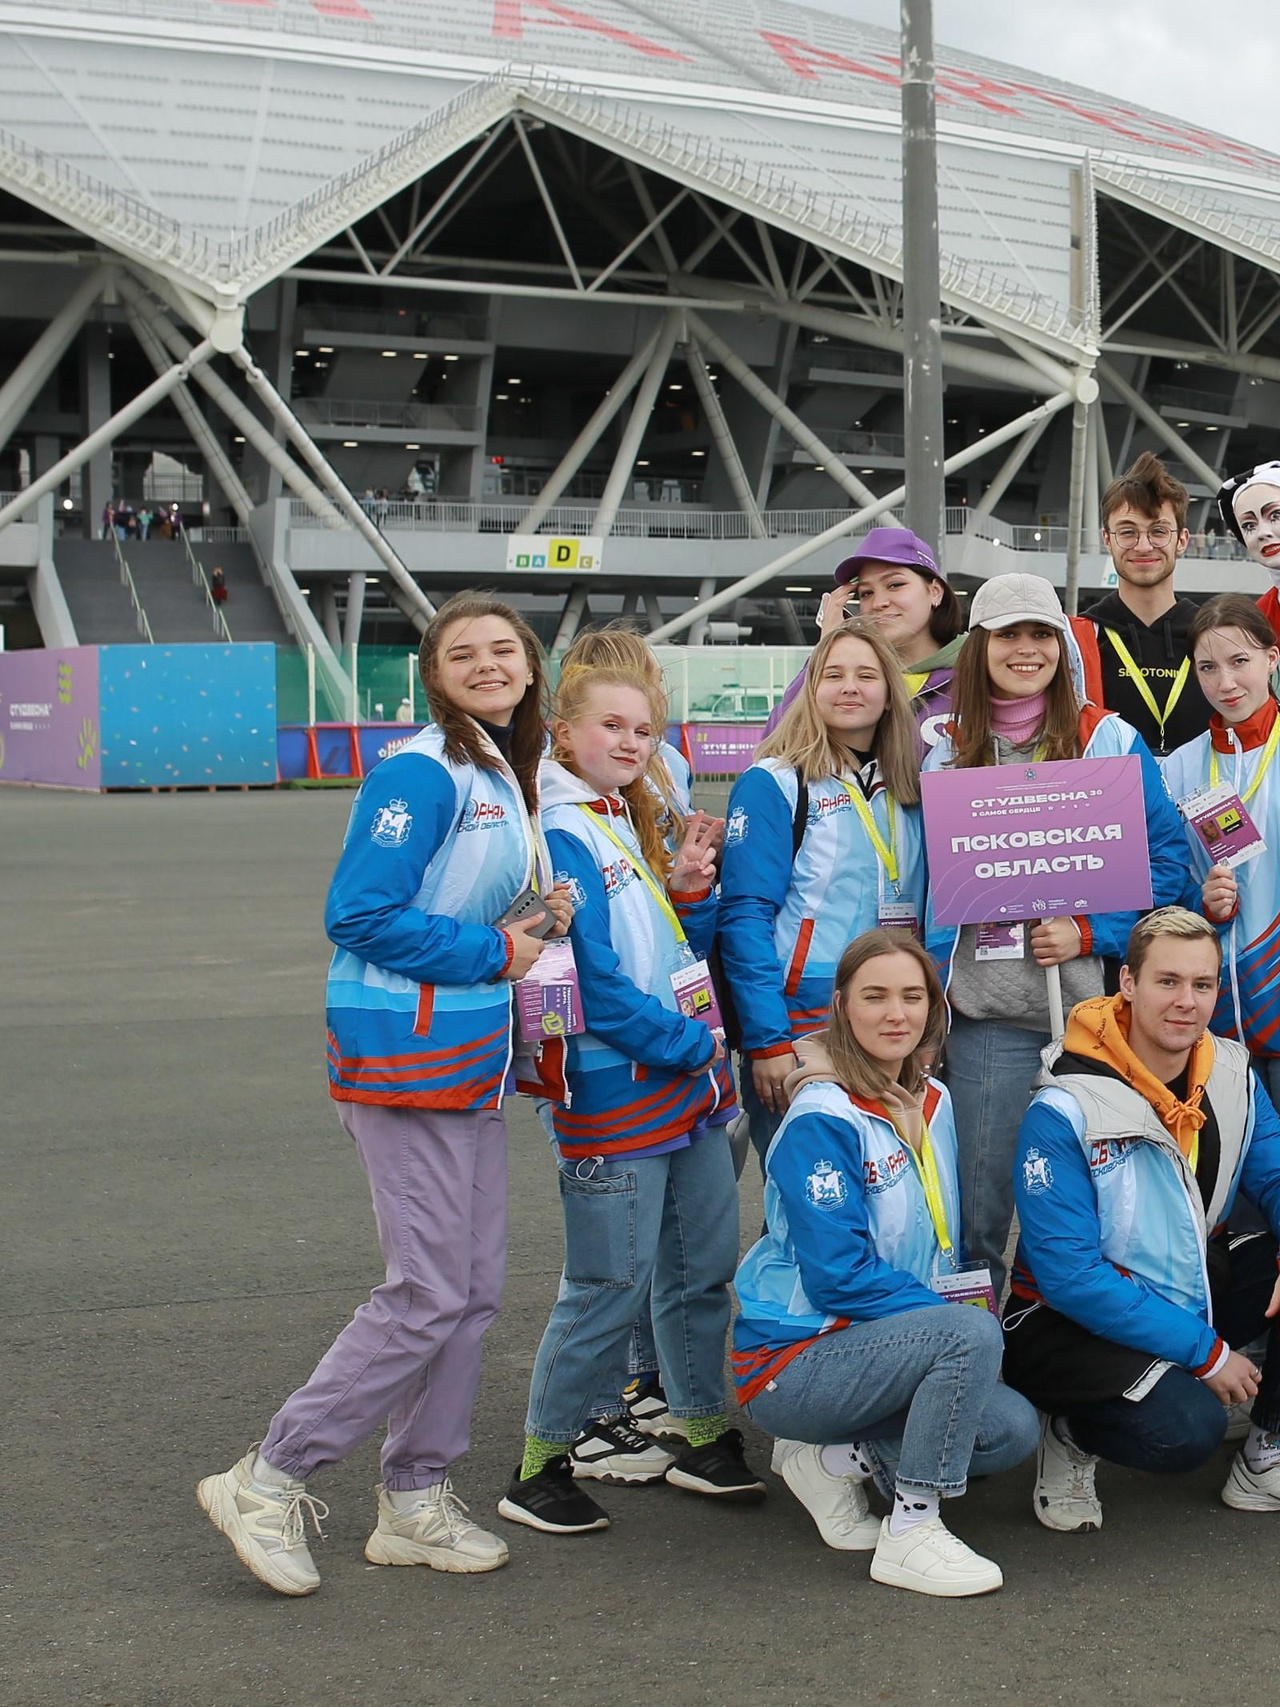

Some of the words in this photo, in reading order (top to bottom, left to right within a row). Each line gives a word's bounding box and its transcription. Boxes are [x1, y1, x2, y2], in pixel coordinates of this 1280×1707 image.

[557, 545, 571, 562] D
[970, 790, 1089, 809] СТУДВЕСНА
[979, 809, 1008, 817] САМОЕ
[1009, 807, 1041, 815] СЕРДЦЕ
[951, 824, 1123, 853] ПСКОВСКАЯ
[974, 854, 1105, 879] ОБЛАСТЬ
